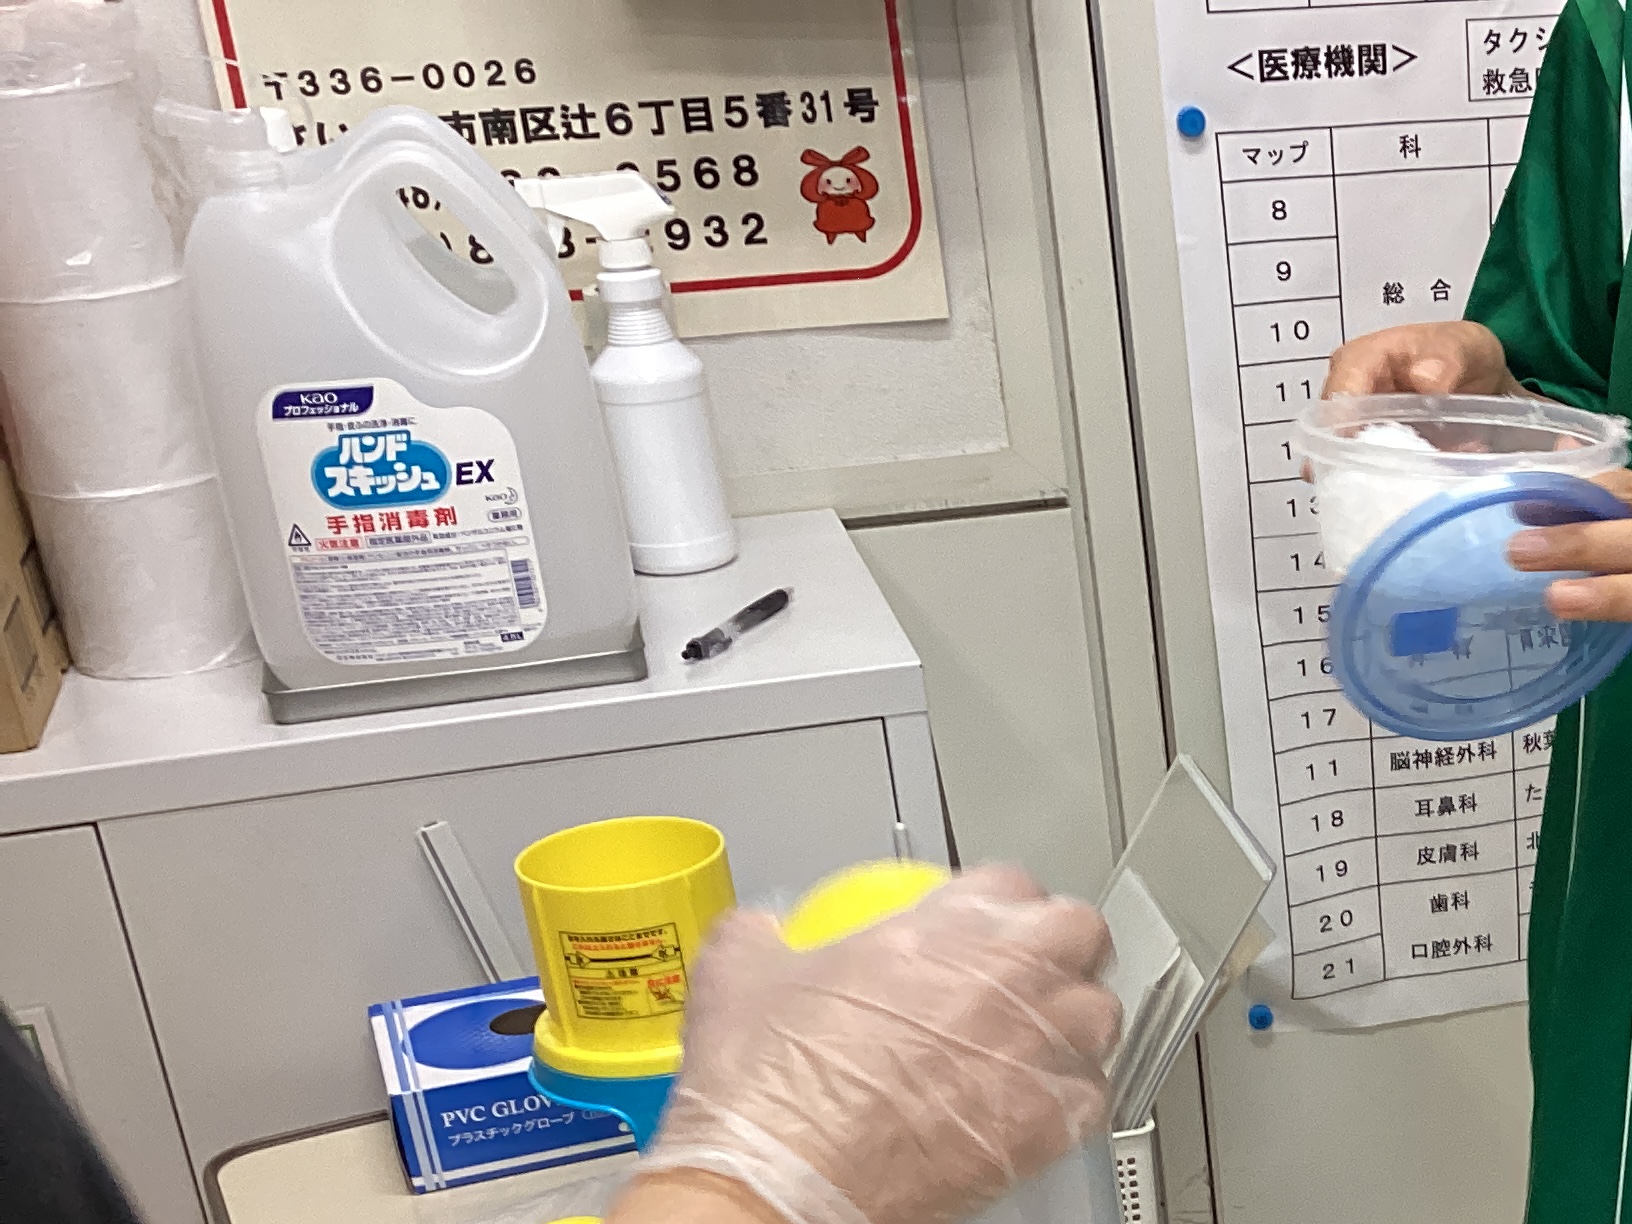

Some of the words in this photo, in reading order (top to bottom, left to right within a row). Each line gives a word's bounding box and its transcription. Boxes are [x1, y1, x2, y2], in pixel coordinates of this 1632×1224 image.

[1482, 67, 1541, 95] 救急
[1242, 140, 1309, 166] マップ
[1399, 134, 1421, 158] 科
[1271, 200, 1287, 220] 8
[1276, 261, 1292, 281] 9
[1271, 319, 1310, 342] 10
[1276, 379, 1312, 402] 11
[284, 403, 359, 416] プロフェッショナル
[338, 432, 408, 464] ハンド
[323, 460, 441, 498] スキッシュ
[455, 458, 495, 486] EX
[326, 506, 458, 535] 手指消毒剤
[1290, 551, 1326, 571] 14
[1294, 605, 1331, 624] 15
[1297, 657, 1334, 677] 16
[1301, 708, 1338, 730] 17
[1390, 739, 1498, 771] 脳神経外科
[1306, 760, 1338, 781] 11
[1414, 792, 1478, 818] 耳鼻科
[1312, 810, 1344, 832] 18
[1416, 842, 1480, 866] 皮膚科
[1316, 860, 1348, 883] 19
[1430, 891, 1470, 914] 歯科
[1320, 909, 1353, 933] 20
[1411, 934, 1494, 960] 口腔外科
[1323, 958, 1355, 980] 21
[441, 1105, 487, 1128] PVC
[491, 1093, 563, 1118] GLOV
